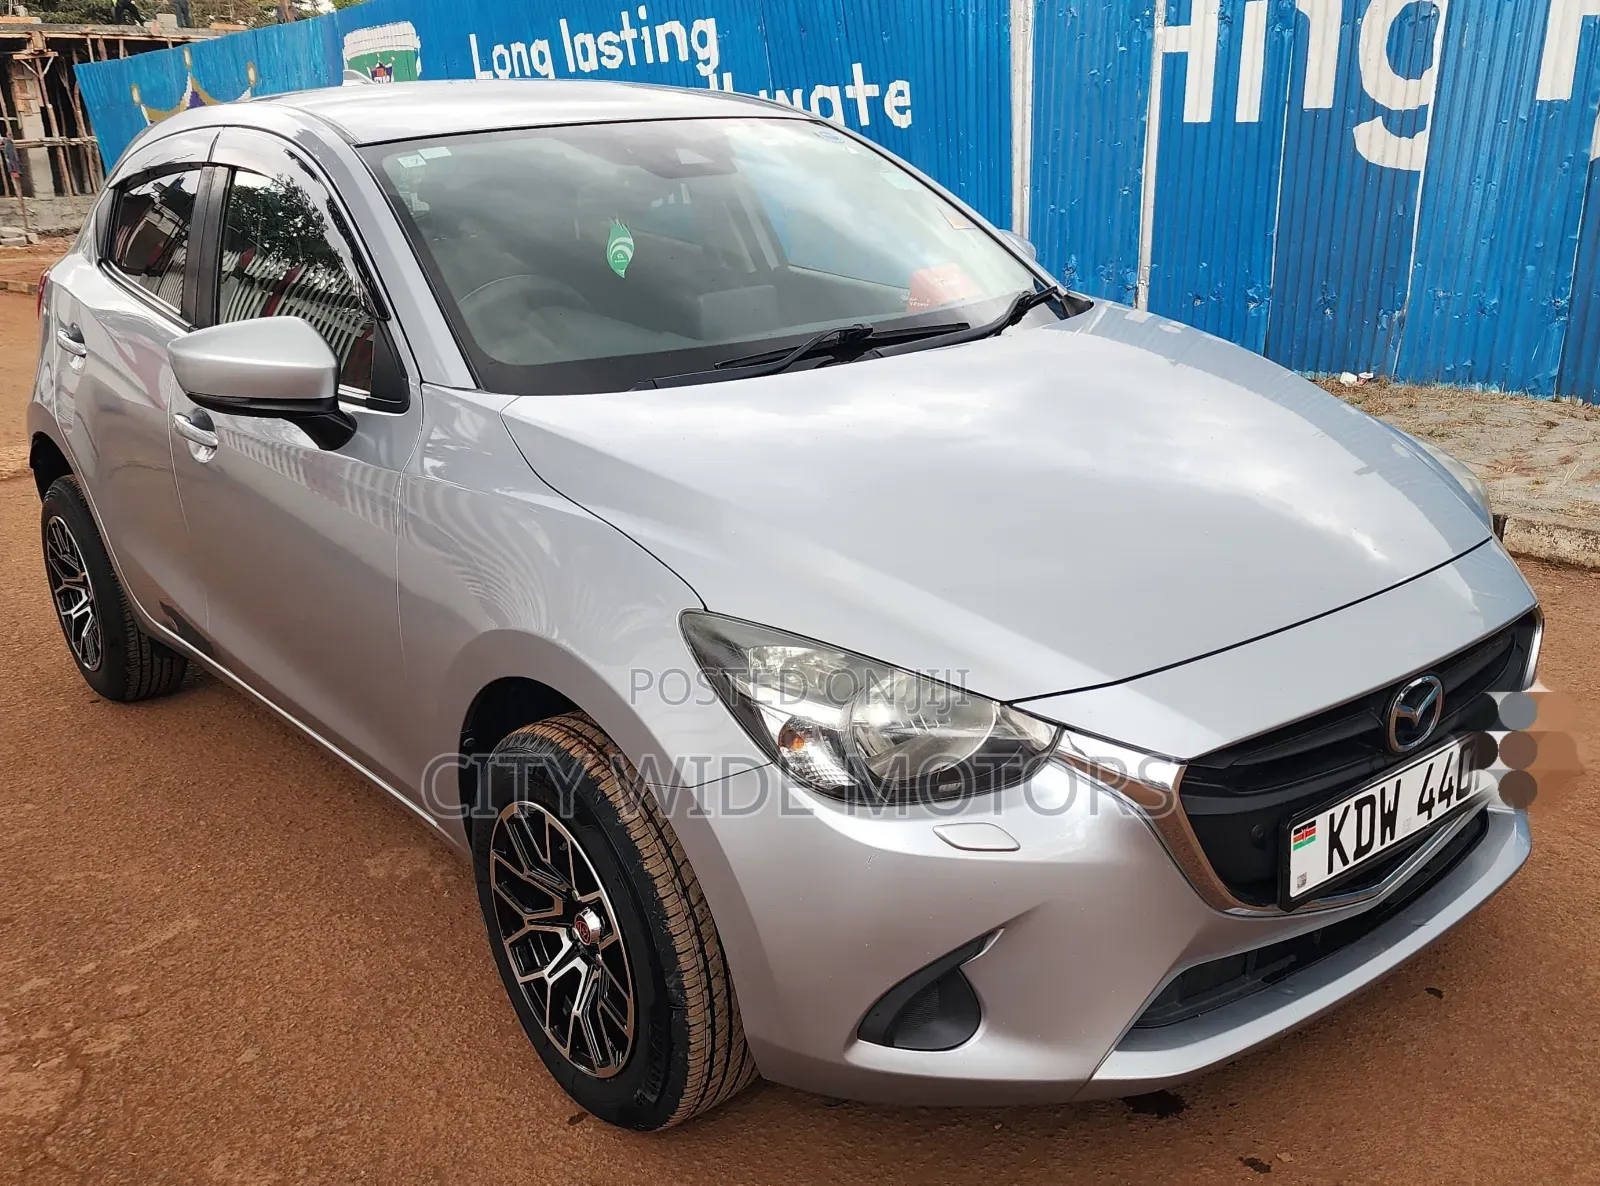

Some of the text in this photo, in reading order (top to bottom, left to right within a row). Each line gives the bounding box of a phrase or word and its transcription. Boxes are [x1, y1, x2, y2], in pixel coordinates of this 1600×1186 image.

[469, 5, 719, 79] Long lasting
[1327, 738, 1480, 875] KDW 440
